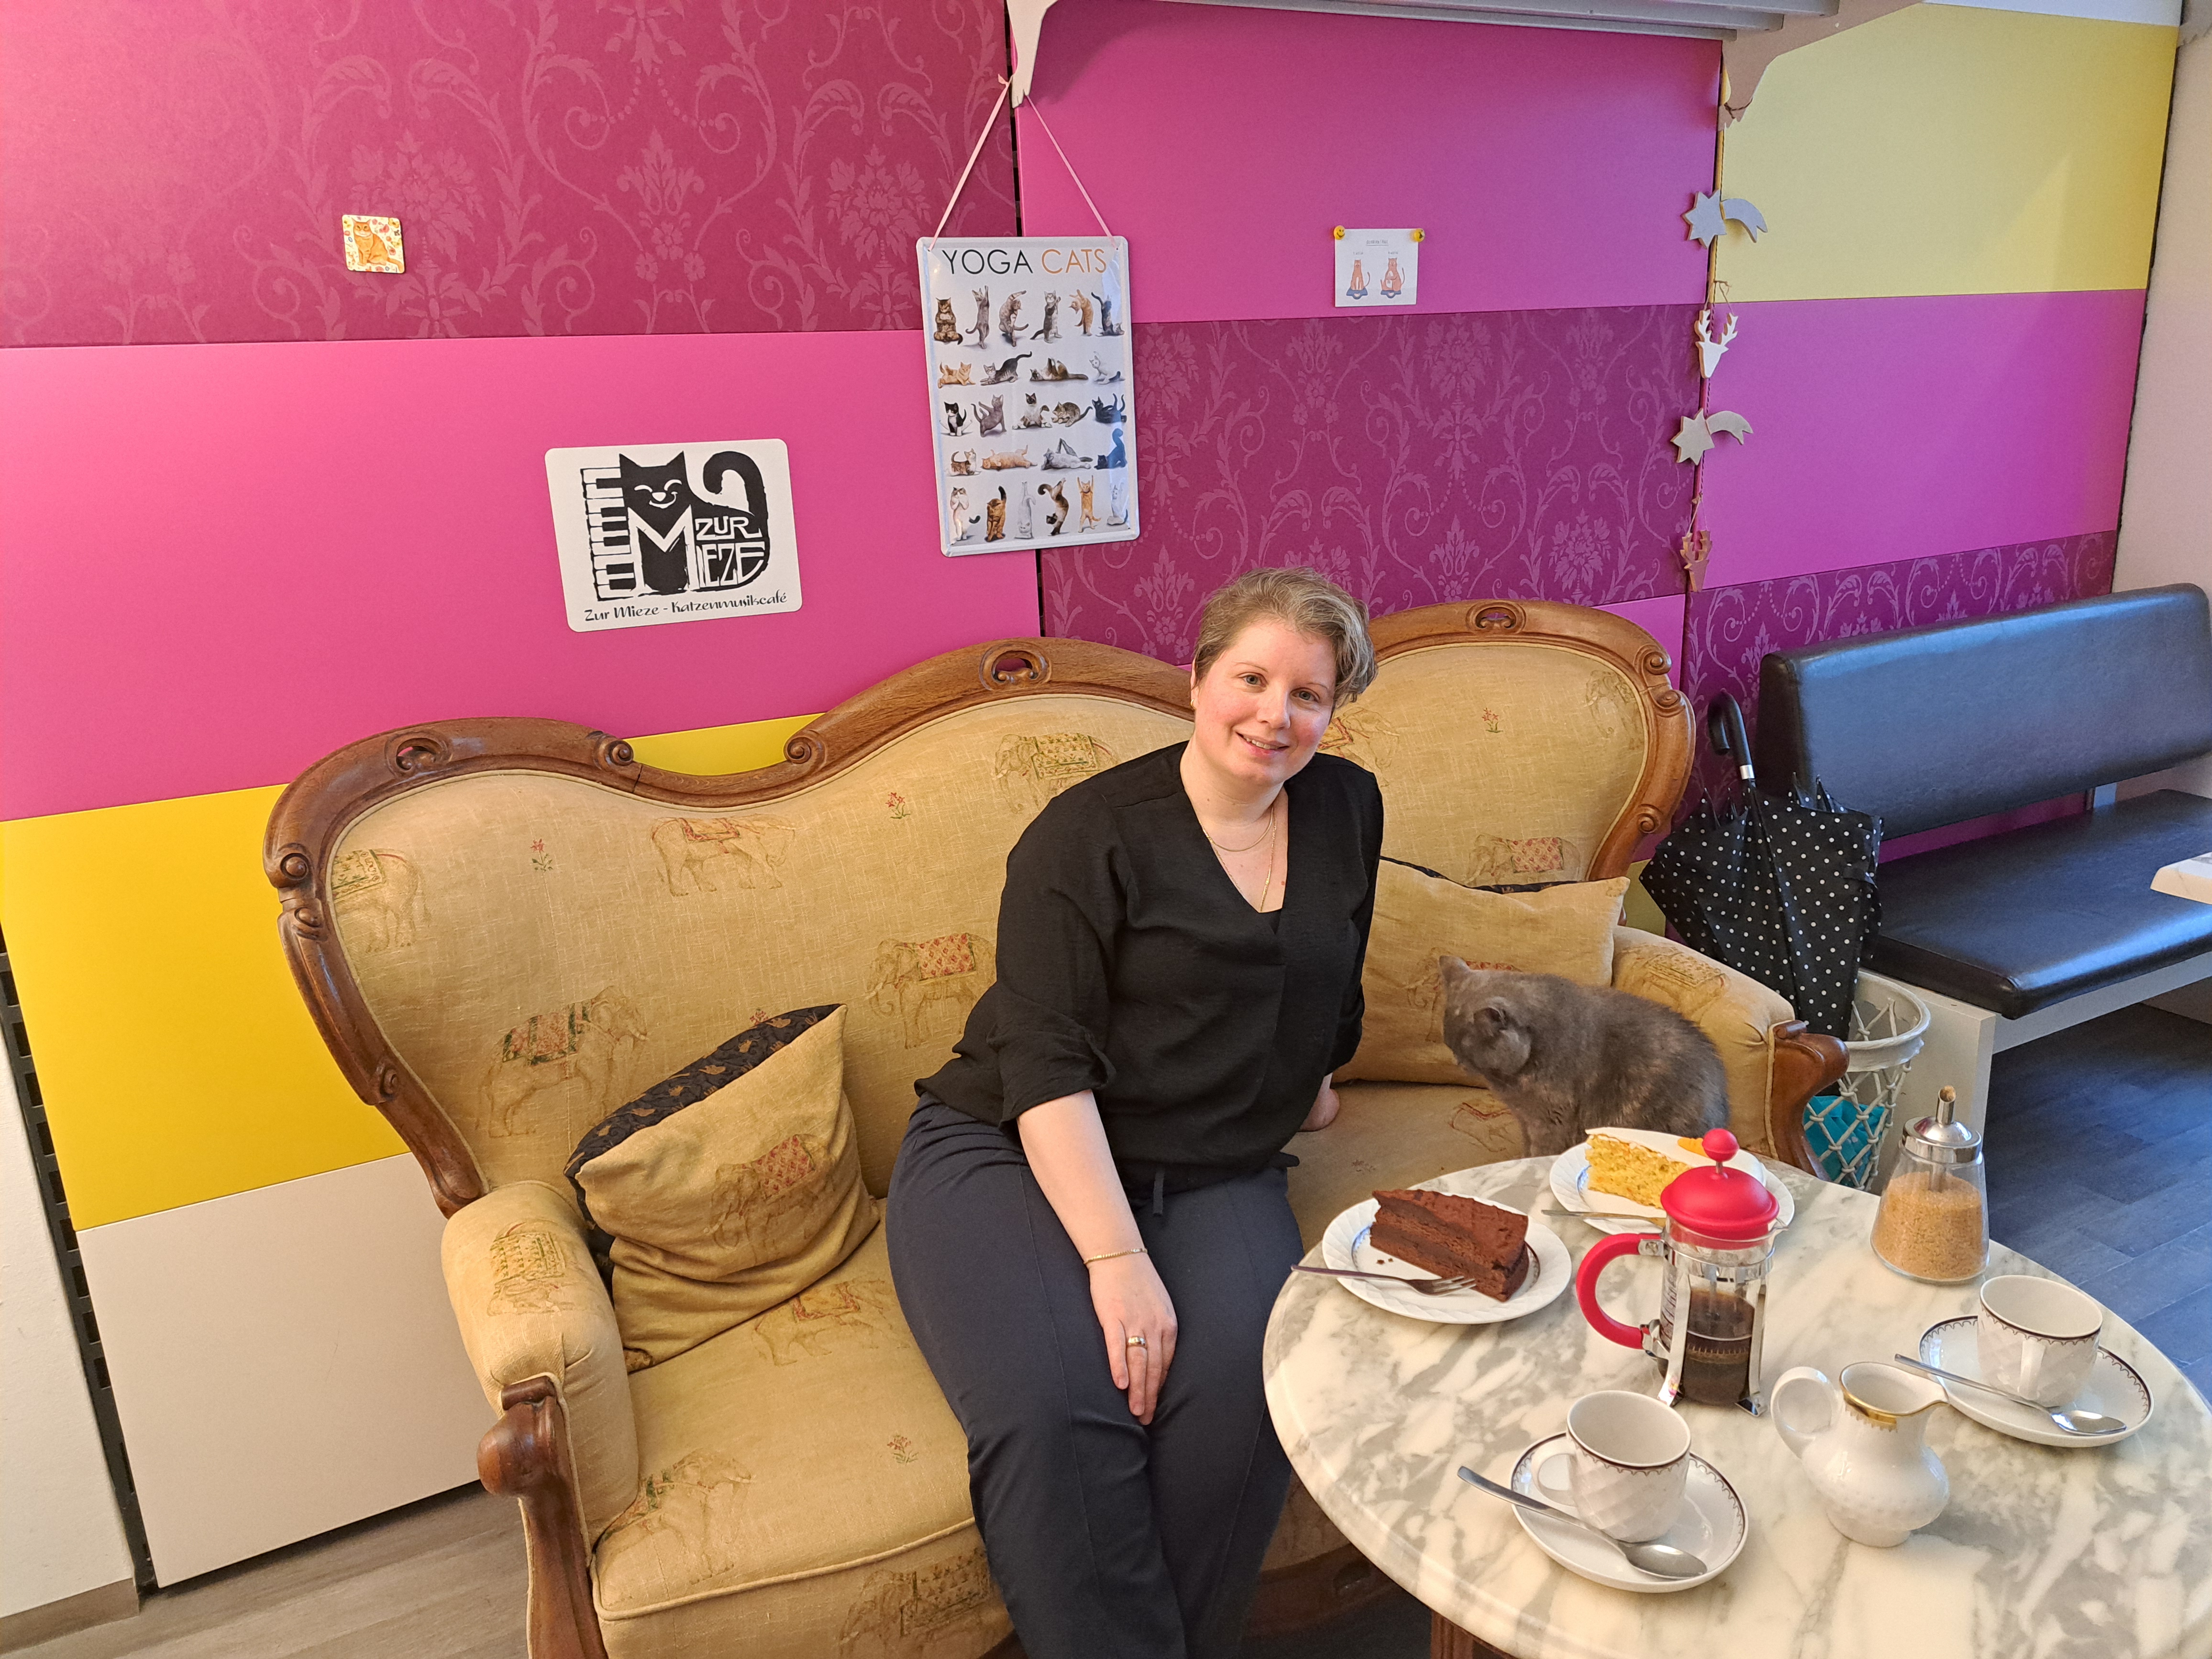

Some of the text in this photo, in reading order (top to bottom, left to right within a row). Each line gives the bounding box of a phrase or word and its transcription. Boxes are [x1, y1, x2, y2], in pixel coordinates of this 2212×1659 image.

[942, 249, 1106, 274] YOGA CATS
[695, 516, 763, 541] ZUR
[584, 609, 610, 621] Zur
[614, 606, 660, 619] Mieze
[671, 589, 787, 613] Katzenmusikcafé
